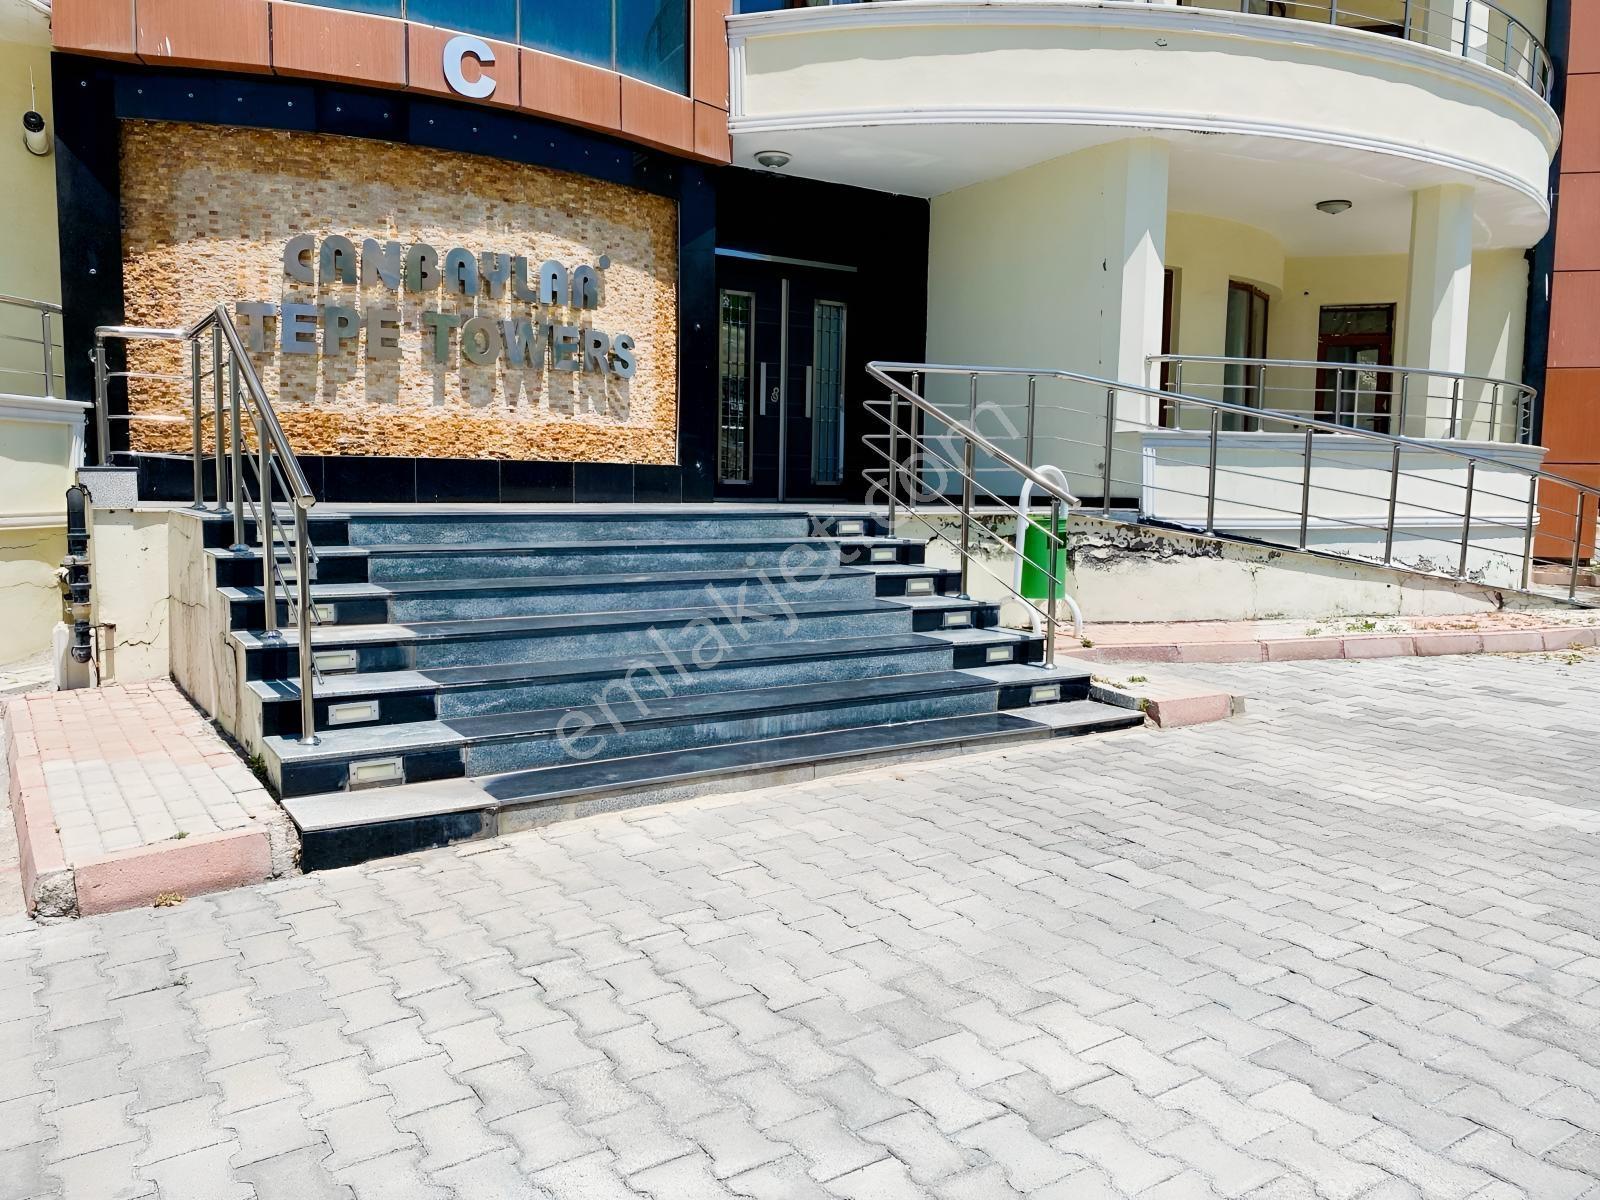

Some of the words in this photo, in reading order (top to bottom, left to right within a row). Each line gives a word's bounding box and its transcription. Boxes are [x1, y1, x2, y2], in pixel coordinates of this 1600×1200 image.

[443, 36, 496, 98] C
[236, 303, 401, 359] TEPE
[422, 310, 636, 379] TOWERS
